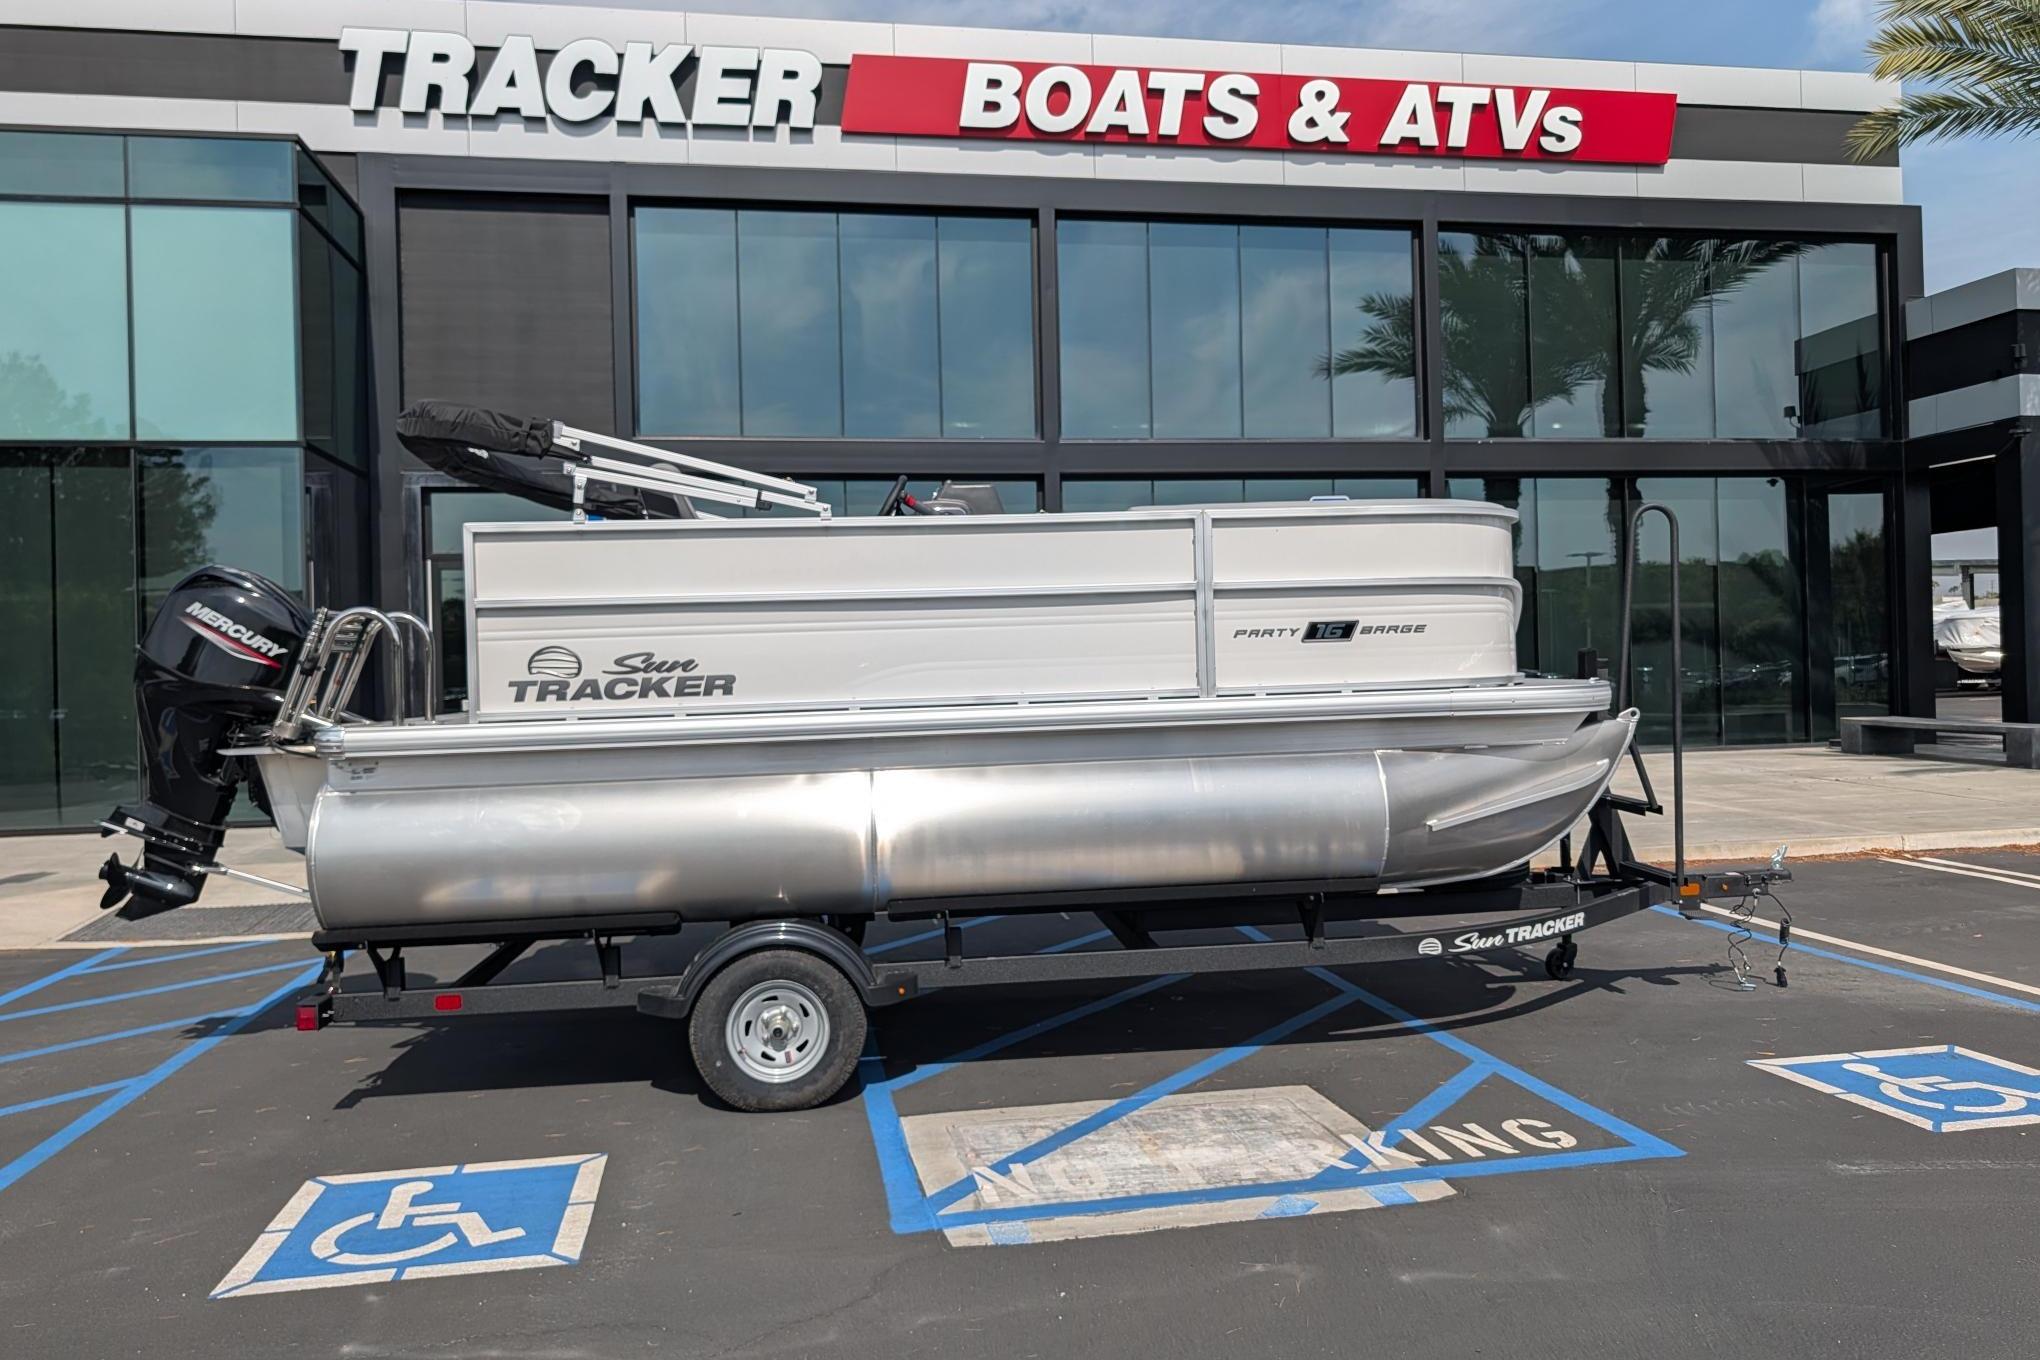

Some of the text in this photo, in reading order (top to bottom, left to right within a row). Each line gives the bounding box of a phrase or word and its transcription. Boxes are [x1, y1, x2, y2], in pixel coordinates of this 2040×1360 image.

[338, 26, 823, 131] TRACKER
[958, 62, 1583, 153] BOATS & ATVs
[184, 600, 289, 658] MERCURY
[1232, 623, 1428, 639] PARTY 16 BARGE
[601, 651, 700, 675] Sun
[507, 673, 737, 703] TRACKER
[1447, 911, 1585, 953] Sun TRACKER
